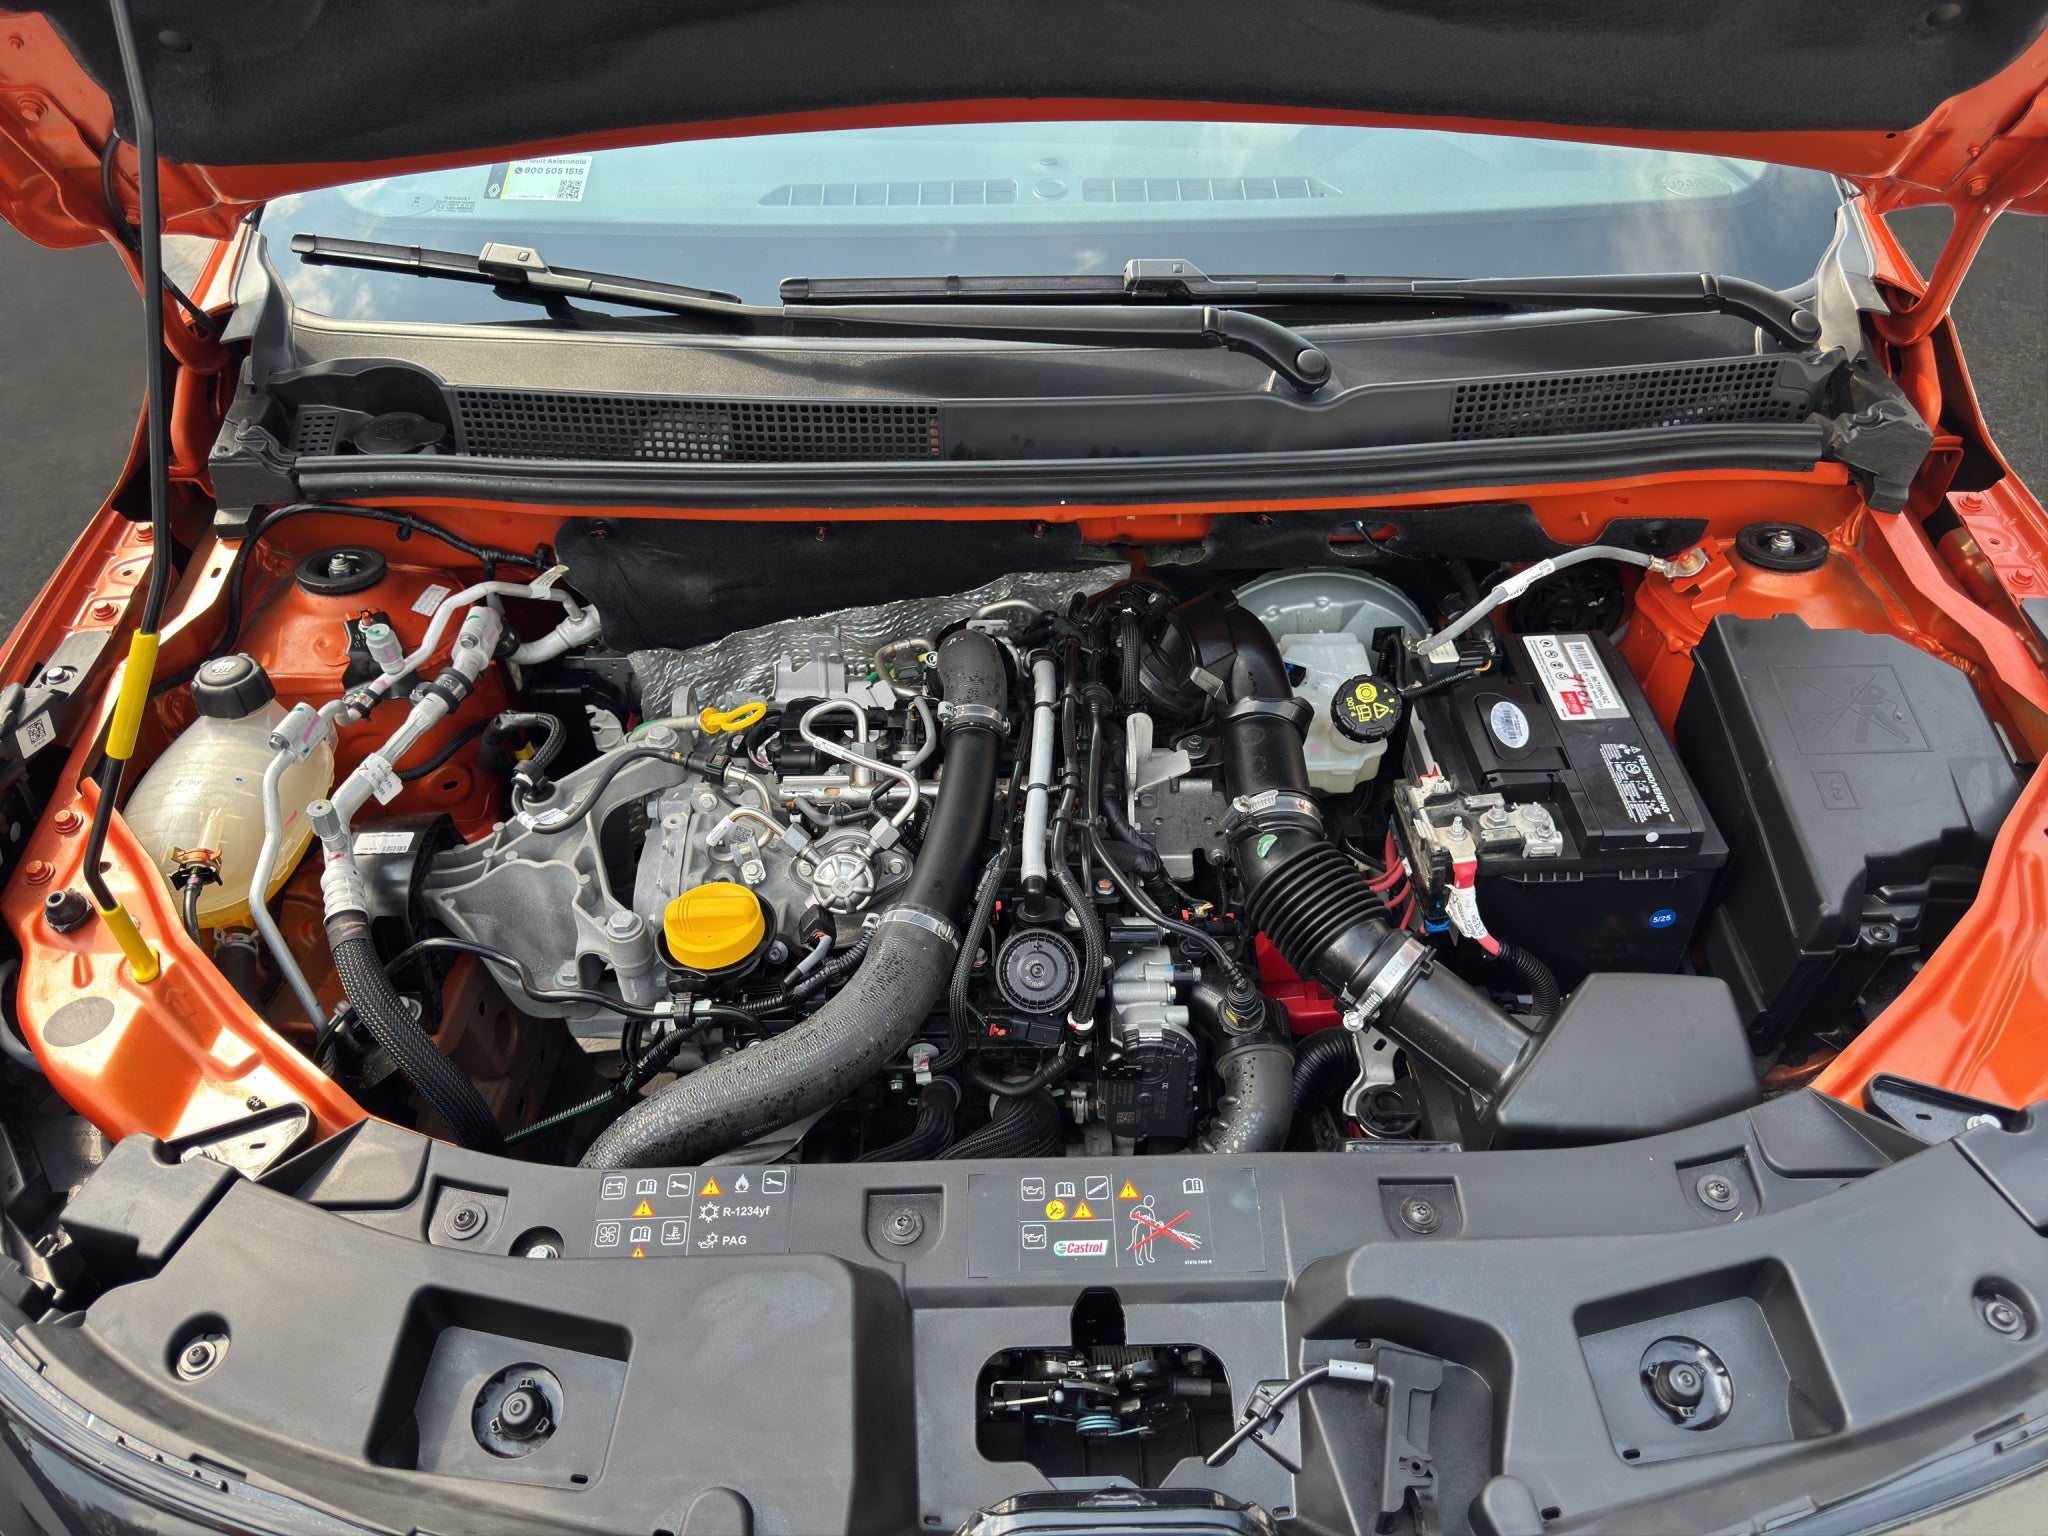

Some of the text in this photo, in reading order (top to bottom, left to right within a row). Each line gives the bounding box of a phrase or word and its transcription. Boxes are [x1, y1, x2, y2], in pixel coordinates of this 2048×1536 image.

[1346, 697, 1355, 711] DOT
[1652, 914, 1672, 923] 5/25
[722, 1205, 771, 1218] R-1234yf
[722, 1235, 747, 1245] PAG
[1067, 1242, 1103, 1254] Castrol
